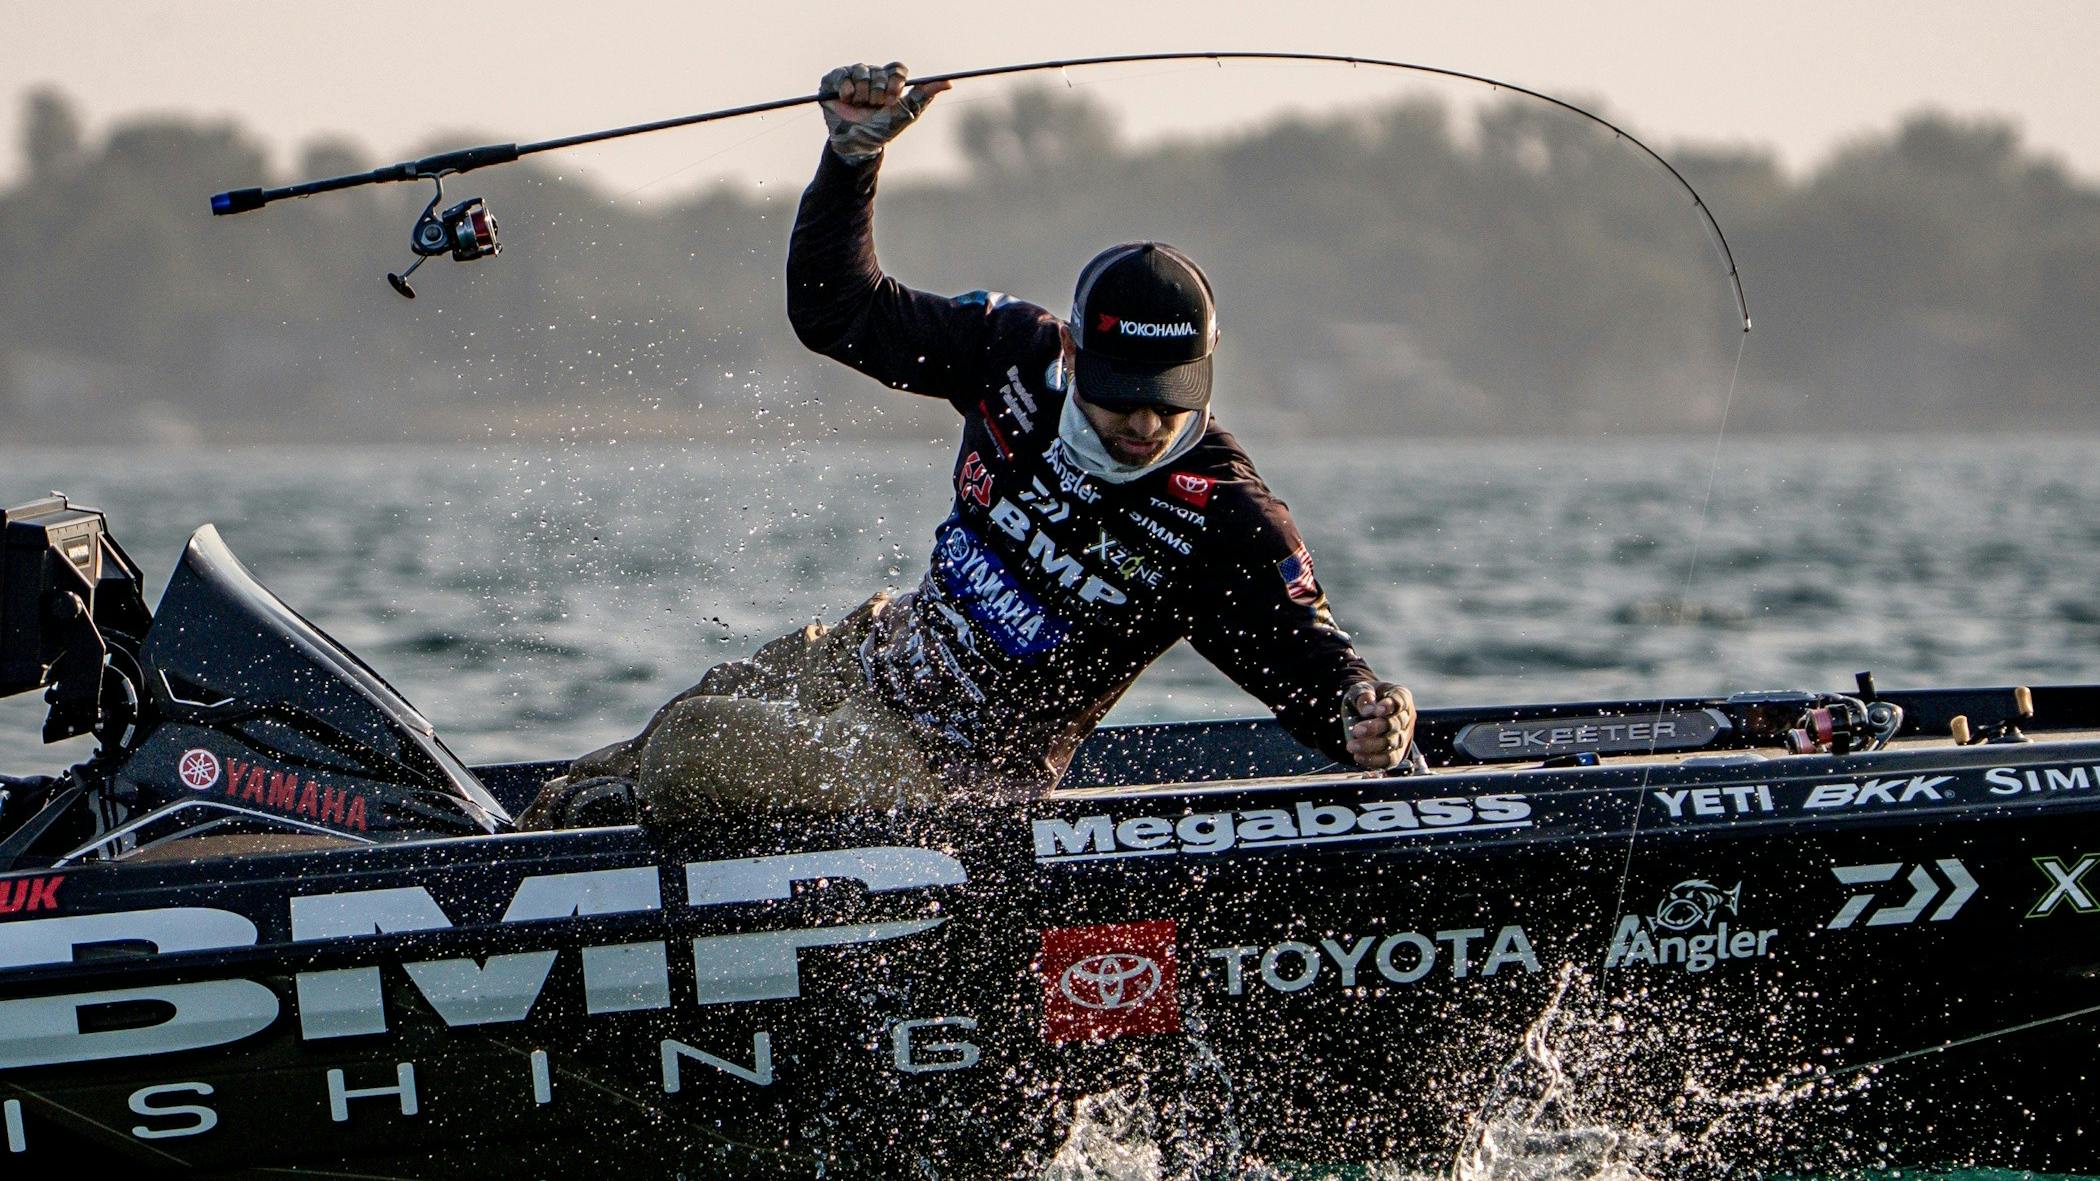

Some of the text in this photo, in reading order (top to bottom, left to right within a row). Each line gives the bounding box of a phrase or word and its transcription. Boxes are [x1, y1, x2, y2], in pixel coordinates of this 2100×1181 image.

[1120, 320, 1193, 337] YOKOHAMA
[1128, 510, 1193, 555] SIMMS
[1150, 496, 1206, 527] TOYOTA
[988, 496, 1128, 605] BMP
[960, 546, 1044, 642] YAMAHA
[1499, 721, 1677, 748] SKEETER
[225, 756, 368, 832] YAMAHA
[1653, 784, 1774, 817] YETI
[1984, 766, 2100, 795] SIM
[1031, 793, 1533, 857] Megabass
[0, 845, 968, 1069] BMP
[1209, 924, 1543, 995] TOYOTA
